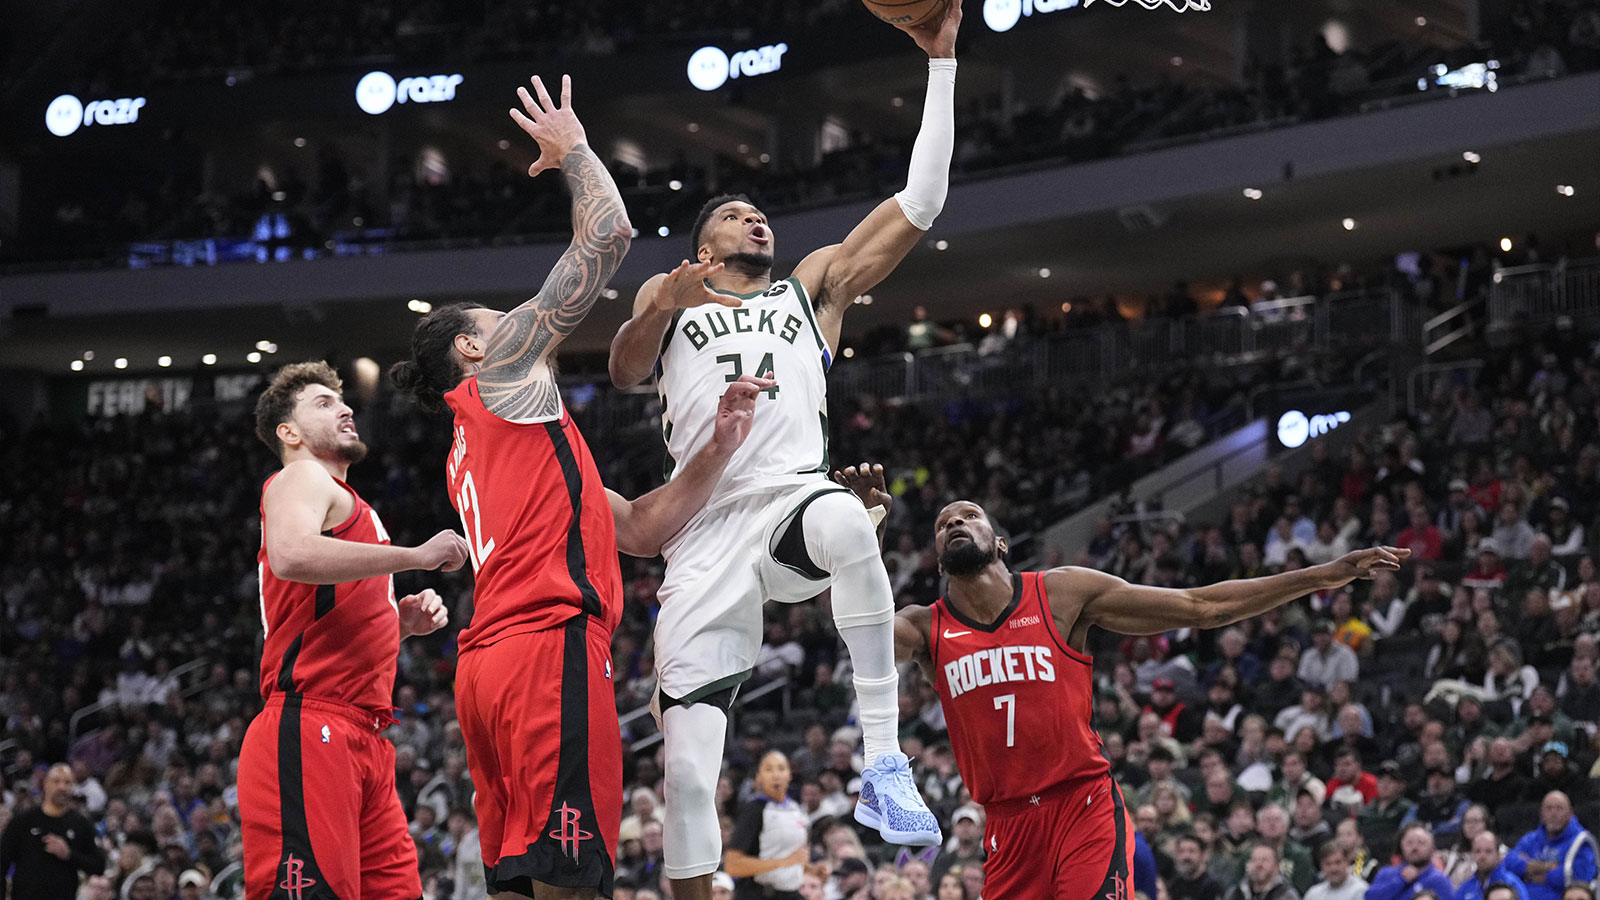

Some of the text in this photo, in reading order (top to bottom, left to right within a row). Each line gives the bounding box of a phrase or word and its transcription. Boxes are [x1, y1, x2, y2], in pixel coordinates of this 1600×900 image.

[729, 42, 788, 79] razr
[396, 73, 464, 104] razr
[83, 96, 147, 127] razr
[682, 308, 802, 351] BUCKS
[456, 470, 496, 575] 12
[944, 645, 1056, 699] ROCKETS
[993, 693, 1016, 747] 7
